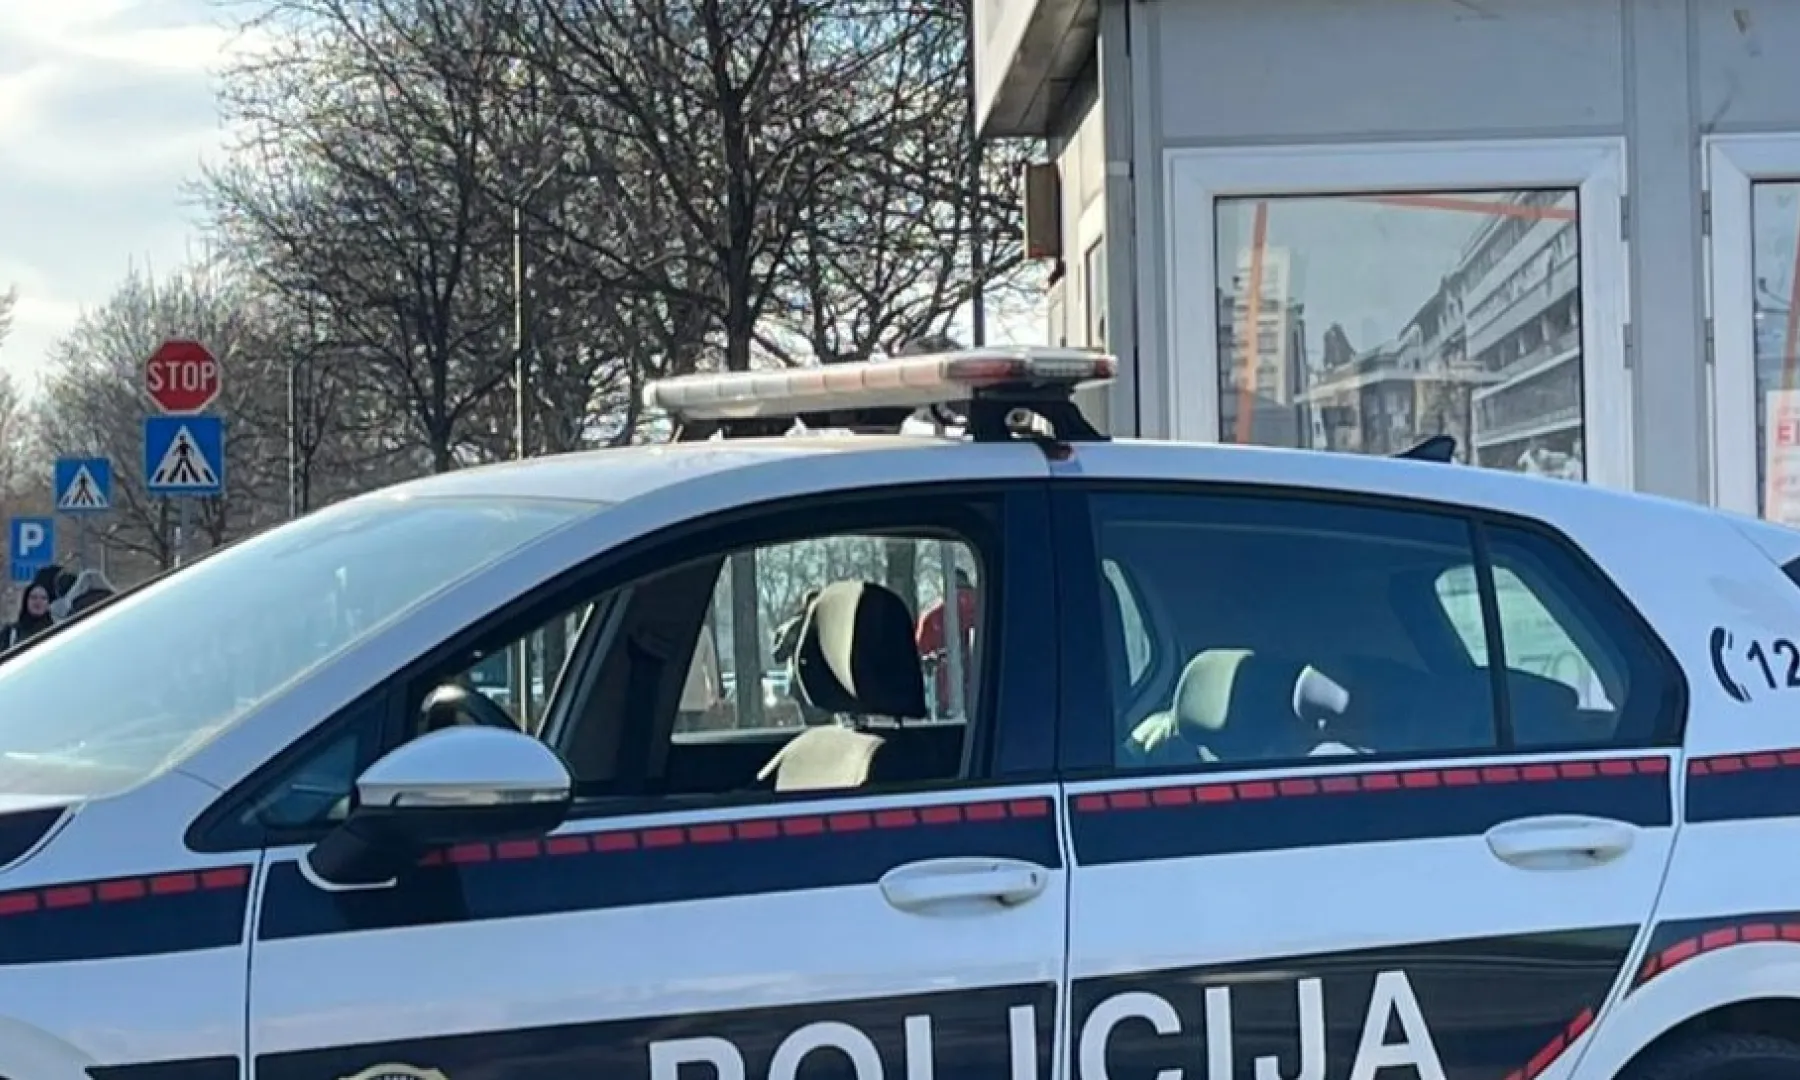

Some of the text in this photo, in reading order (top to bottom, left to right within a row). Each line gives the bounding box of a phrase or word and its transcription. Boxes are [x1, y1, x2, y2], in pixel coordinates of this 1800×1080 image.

[148, 360, 215, 392] STOP
[19, 522, 44, 556] P
[1747, 638, 1800, 690] 12
